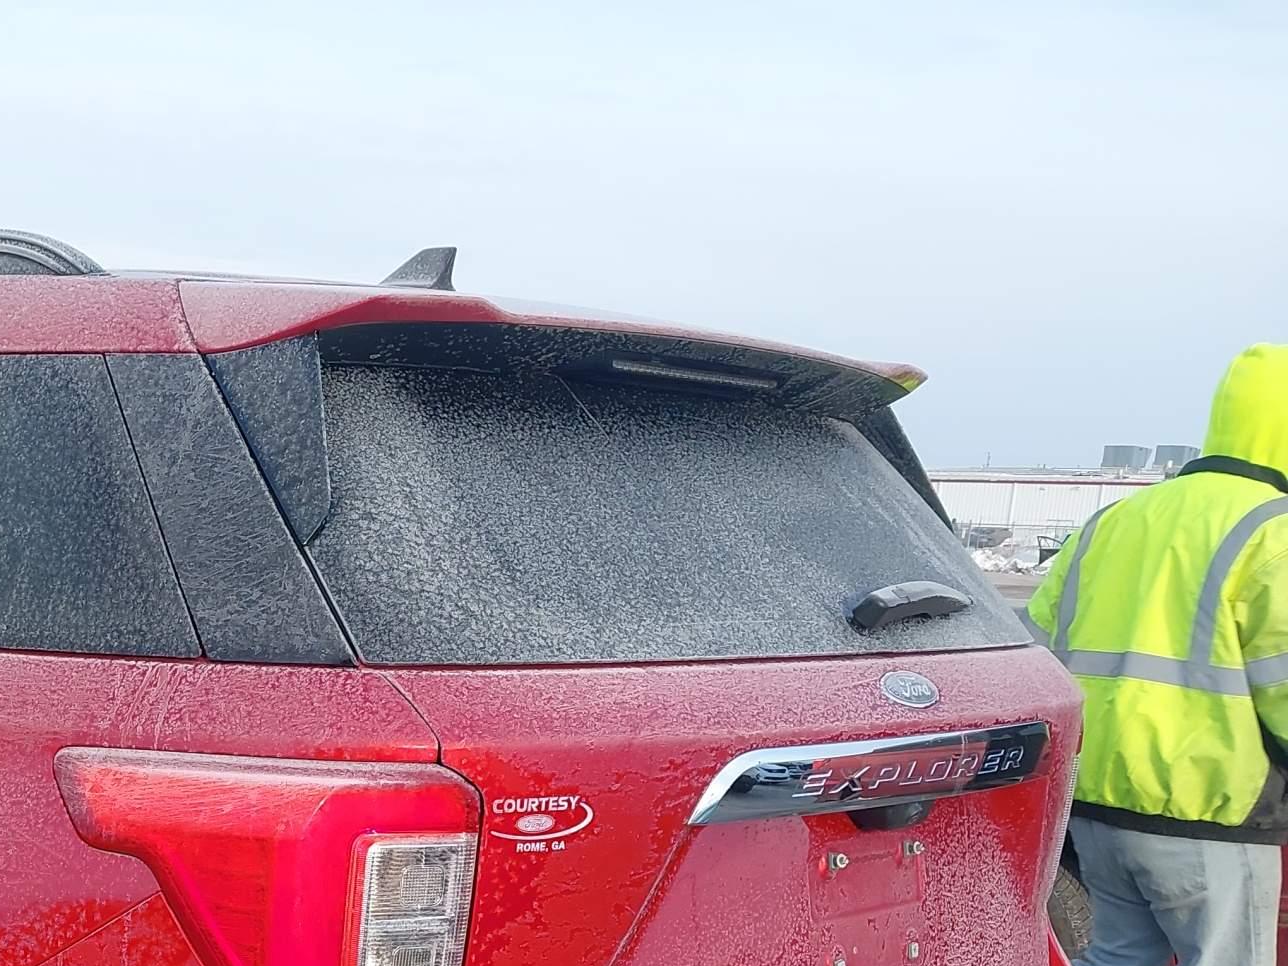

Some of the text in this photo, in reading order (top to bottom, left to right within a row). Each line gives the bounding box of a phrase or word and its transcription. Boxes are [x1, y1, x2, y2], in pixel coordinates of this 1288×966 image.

[791, 745, 1024, 798] EXPLORER
[492, 795, 580, 814] COURTESY
[516, 840, 565, 853] ROME, GA
